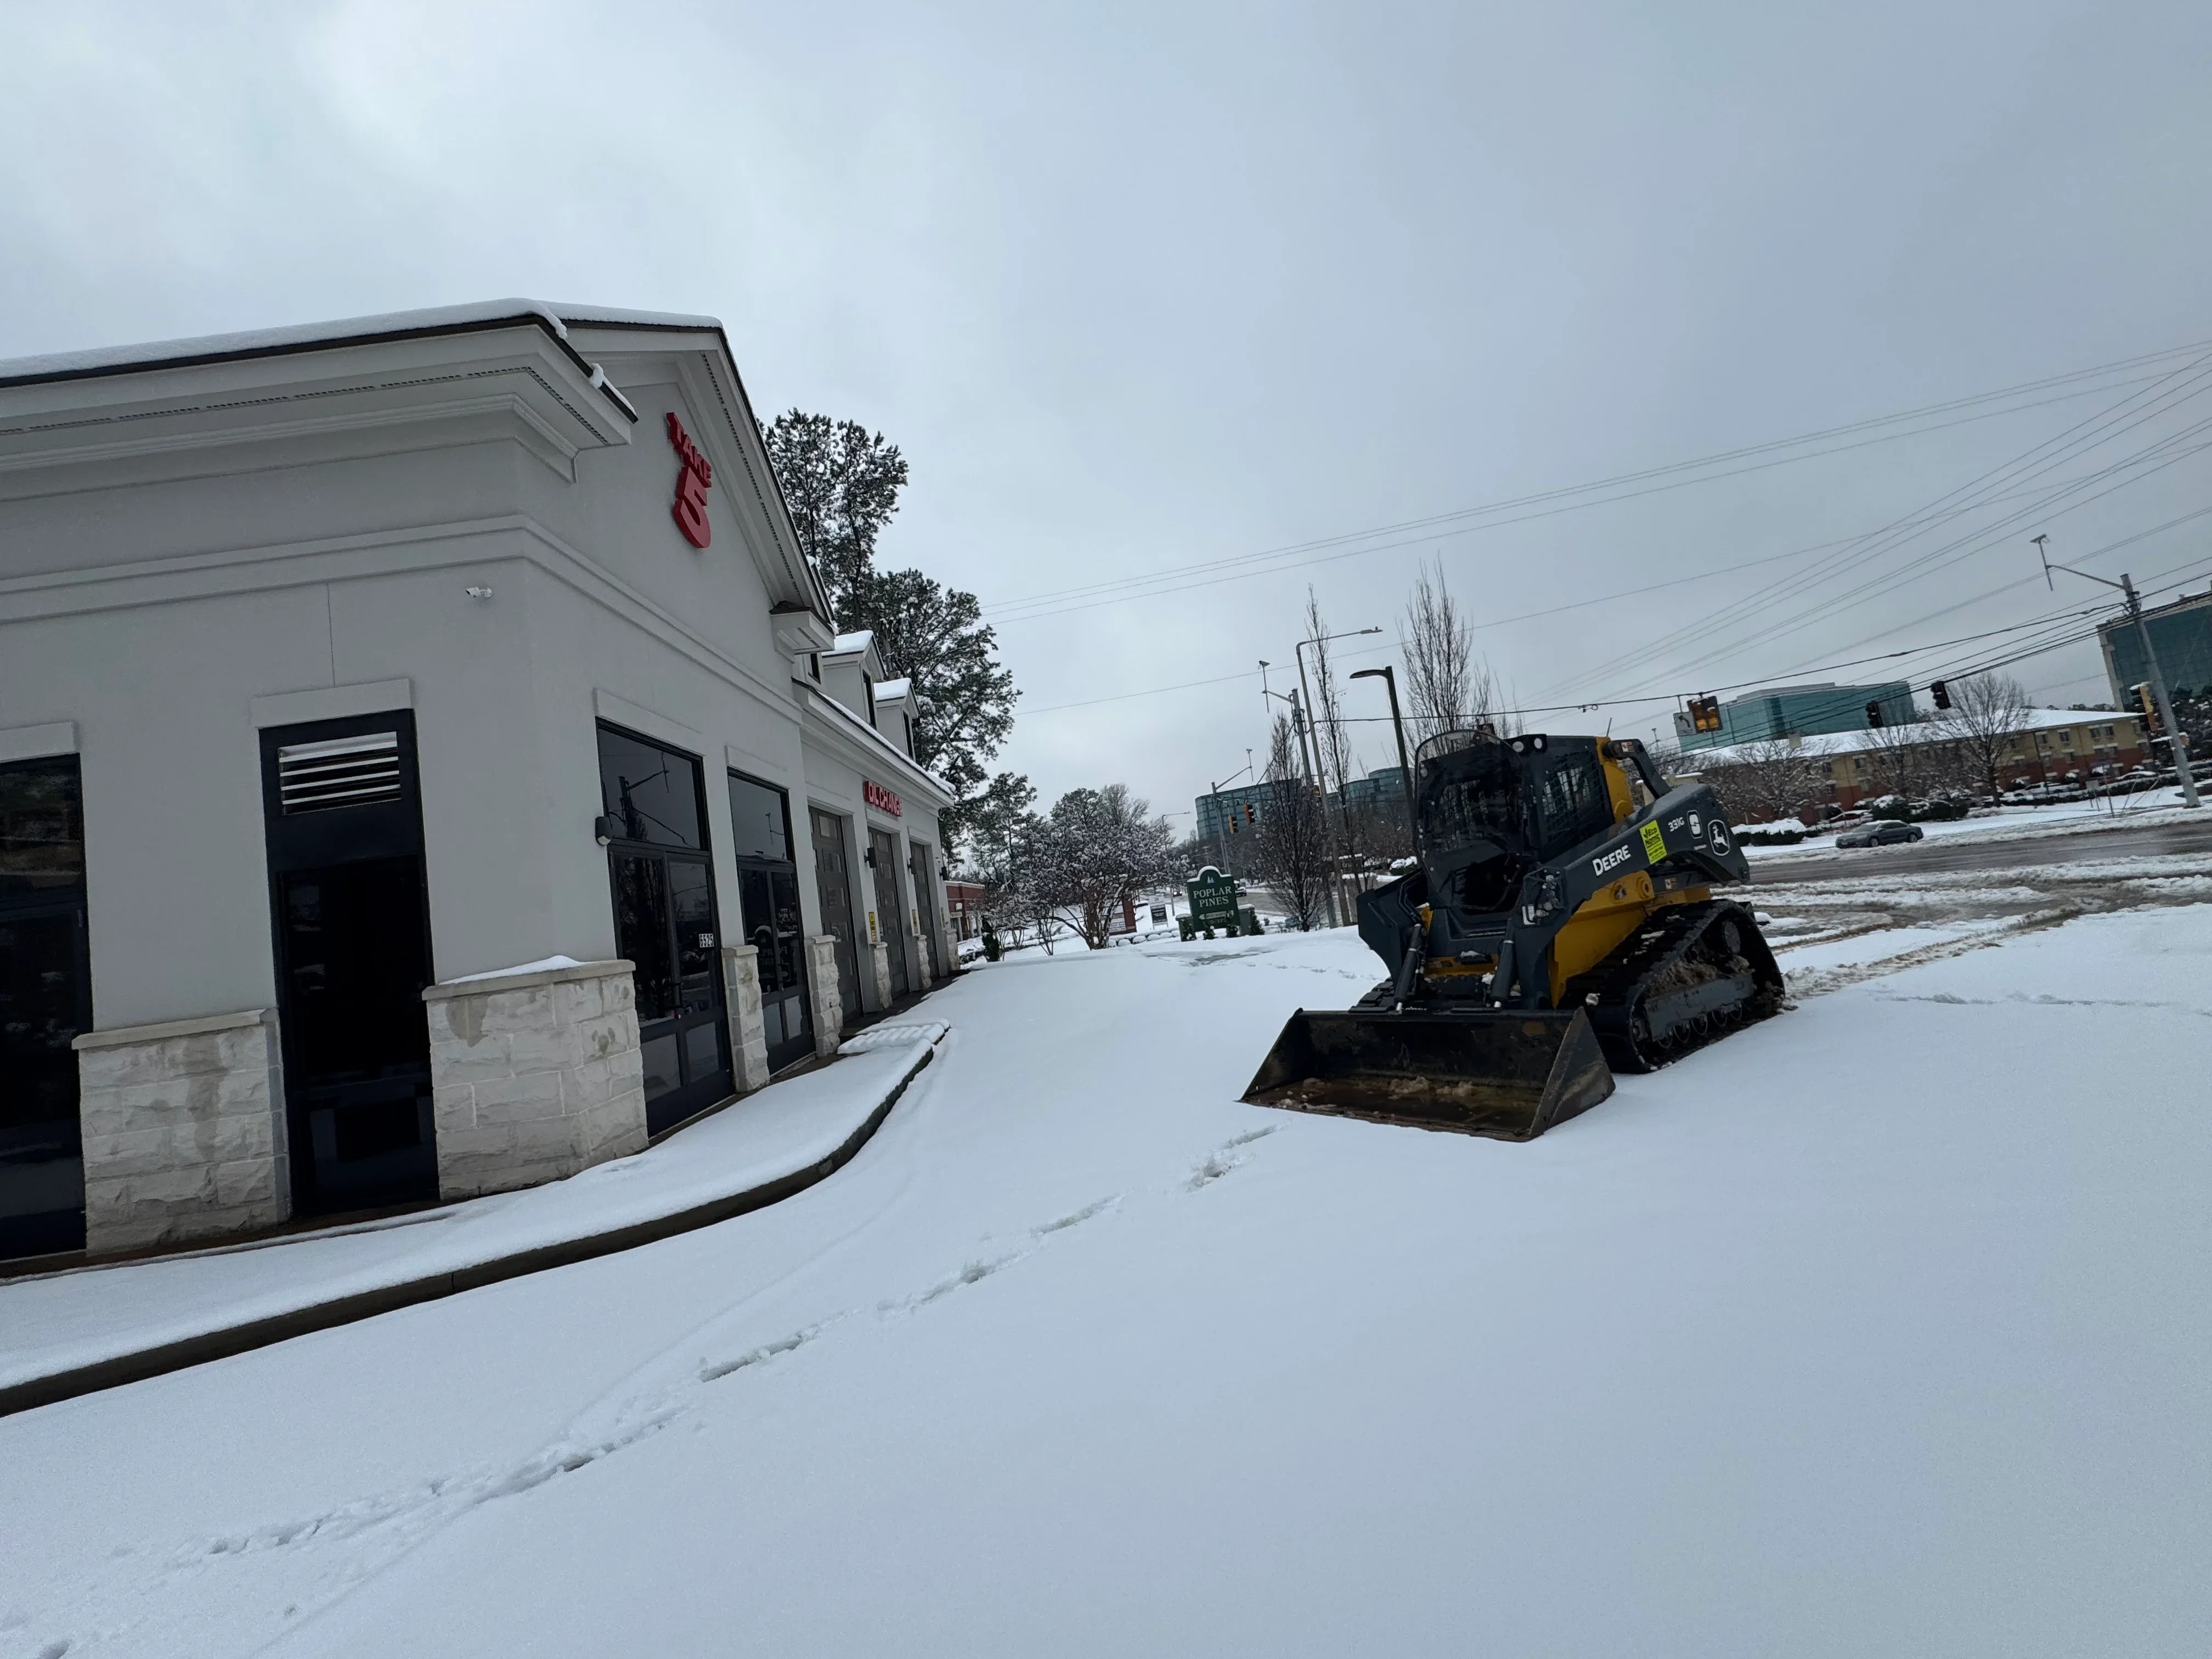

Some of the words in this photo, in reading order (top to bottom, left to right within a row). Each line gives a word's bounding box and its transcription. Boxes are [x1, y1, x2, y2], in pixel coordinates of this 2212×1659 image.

[673, 466, 712, 548] 5
[865, 781, 879, 805] OIL
[879, 787, 903, 817] CHANGE
[1592, 844, 1632, 877] DEERE
[1193, 886, 1232, 899] POPLAR
[1199, 896, 1229, 907] PINES
[699, 934, 713, 947] 6525
